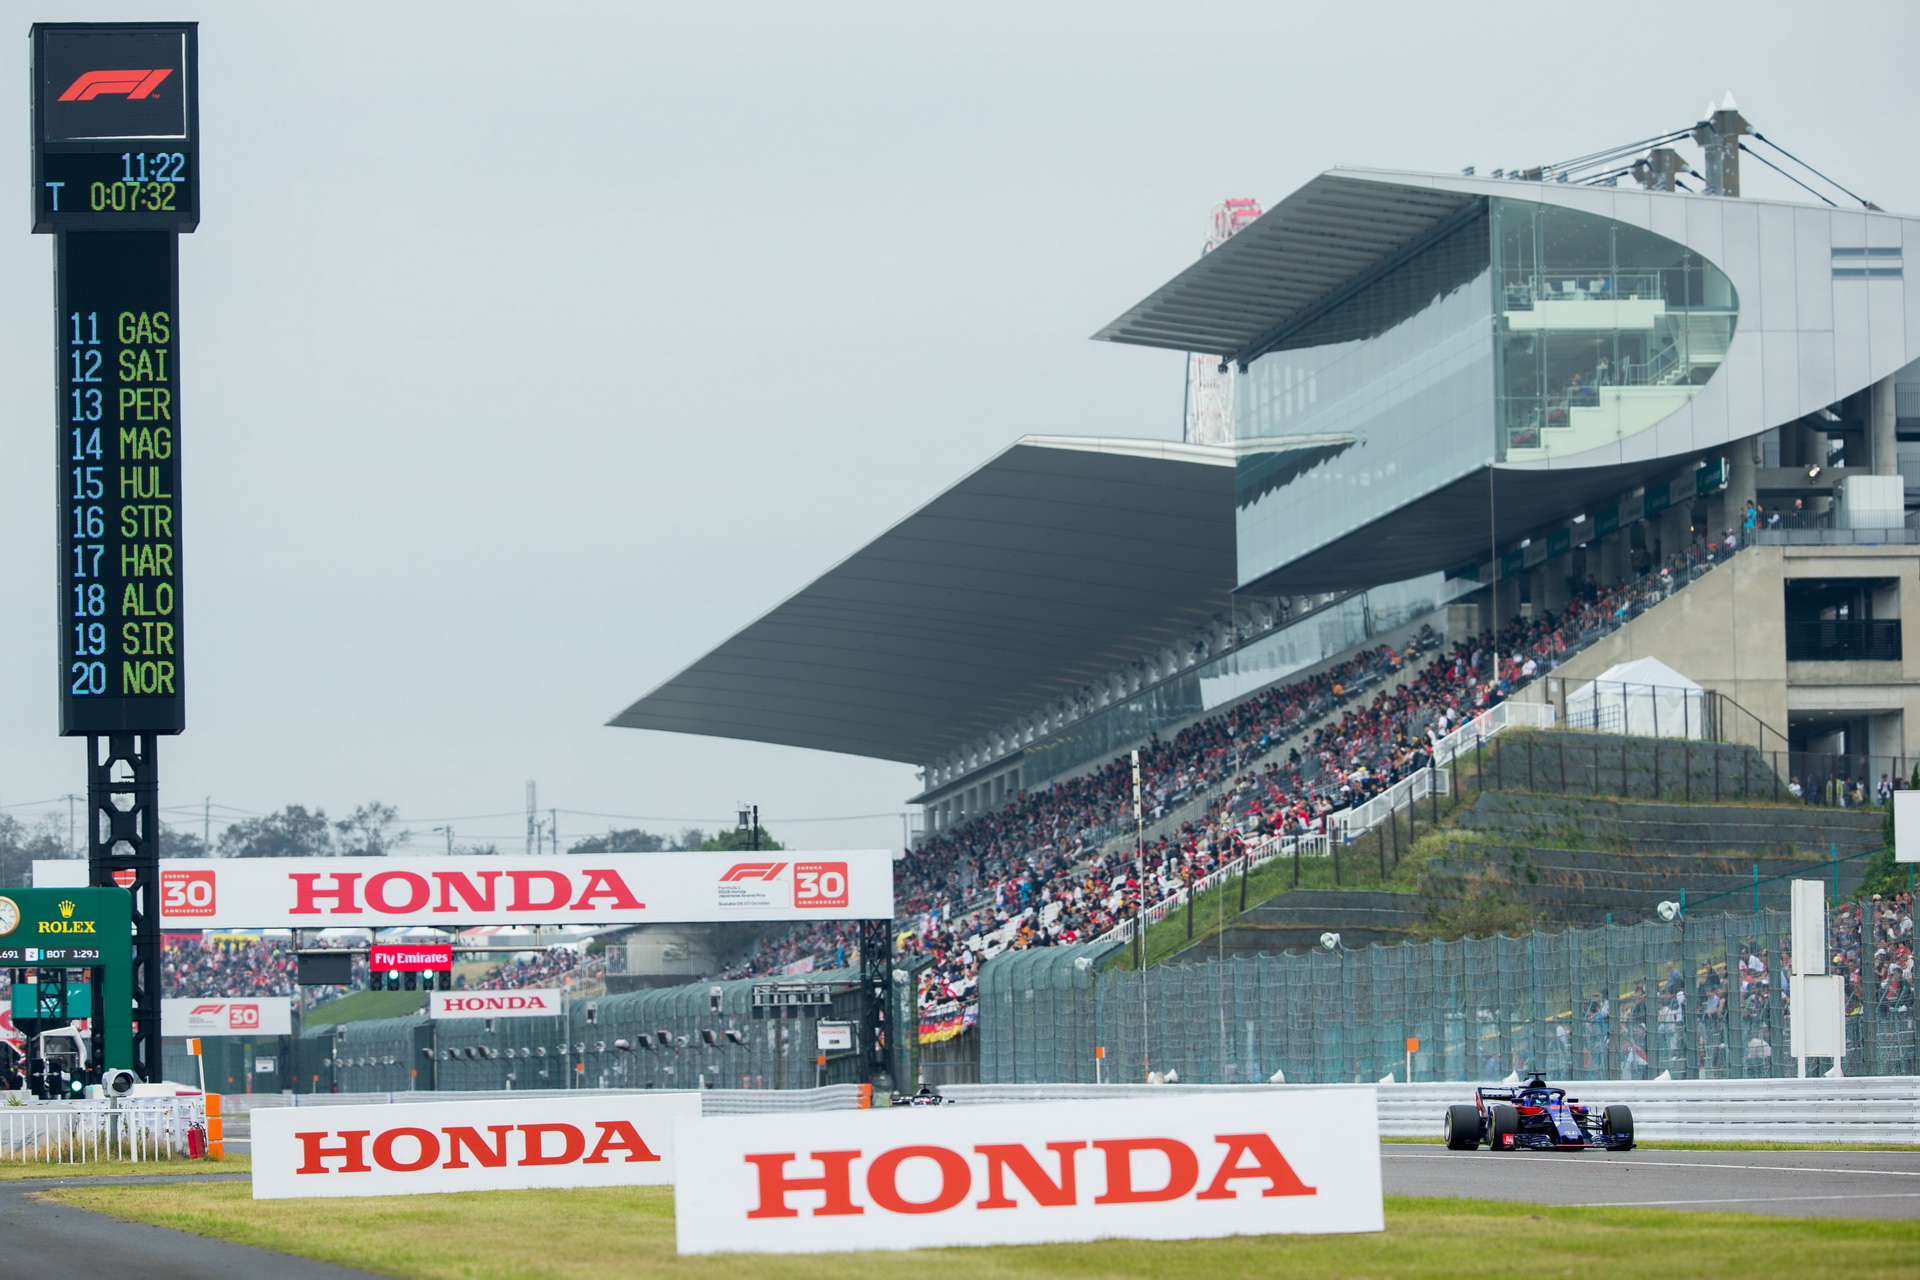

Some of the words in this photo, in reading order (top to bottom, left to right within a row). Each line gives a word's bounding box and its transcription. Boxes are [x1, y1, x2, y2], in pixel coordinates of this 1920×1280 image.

[122, 153, 185, 182] 11:22
[46, 182, 65, 211] T
[90, 182, 176, 211] 0:07:32
[71, 312, 101, 345] 11
[118, 312, 170, 344] GAS
[72, 350, 102, 382] 12
[119, 349, 168, 381] SAI
[72, 389, 103, 421] 13
[120, 388, 171, 420] PER
[72, 428, 103, 460] 14
[120, 427, 171, 459] MAG
[73, 467, 103, 499] 15
[121, 466, 172, 498] HUL
[73, 506, 104, 538] 16
[121, 505, 172, 537] STR
[74, 545, 104, 577] 17
[121, 544, 173, 576] HAR
[74, 584, 105, 617] 18
[122, 583, 173, 616] ALO
[75, 623, 105, 655] 19
[123, 622, 174, 655] SIR
[72, 662, 106, 695] 20
[123, 661, 174, 694] NOR
[163, 880, 213, 907] 30
[289, 869, 646, 914] HONDA
[796, 871, 845, 898] 30
[38, 921, 96, 933] ROLEX
[46, 950, 67, 959] BOT
[375, 952, 395, 965] Fly
[396, 952, 449, 964] Emirates
[230, 1008, 258, 1025] 30
[443, 996, 548, 1011] HONDA
[295, 1121, 660, 1174] HONDA
[744, 1133, 1317, 1219] HONDA
